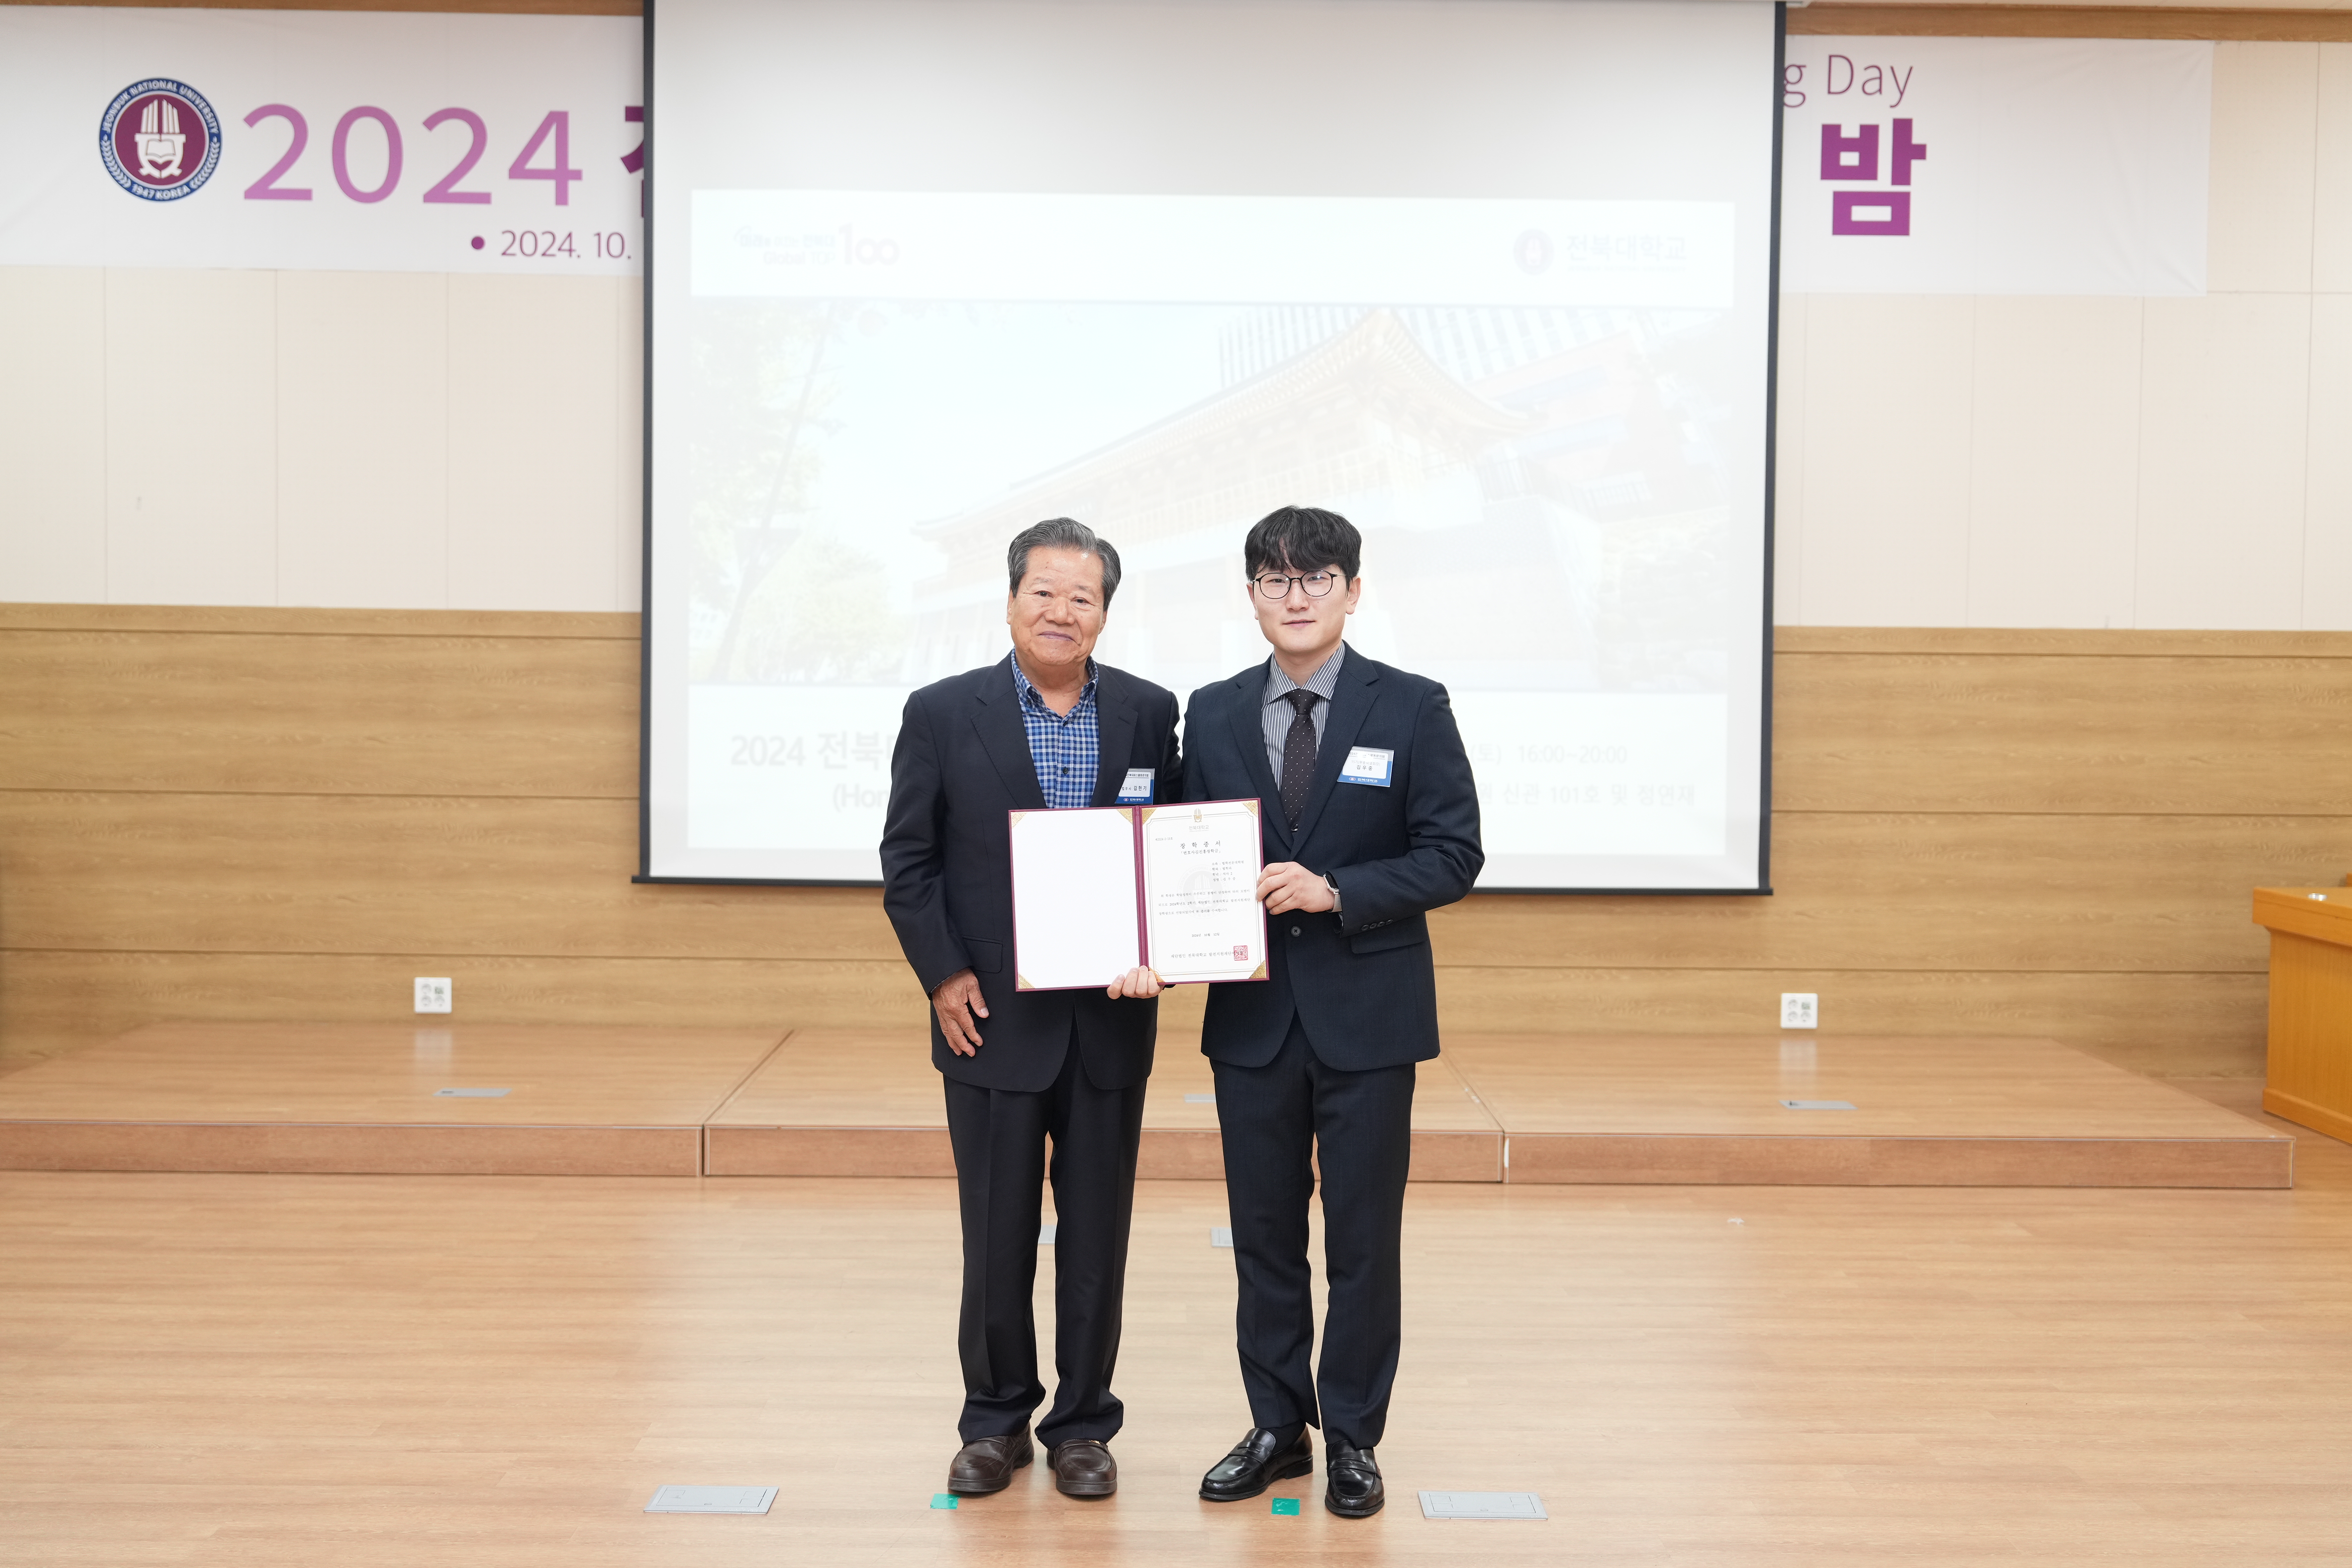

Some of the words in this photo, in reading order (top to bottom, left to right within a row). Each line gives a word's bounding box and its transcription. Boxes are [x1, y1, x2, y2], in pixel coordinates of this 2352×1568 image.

[1827, 54, 1913, 108] Day
[102, 91, 131, 133] JEONBUK
[129, 80, 178, 96] NATIONAL
[179, 85, 219, 134] UNIVERSITY
[243, 103, 584, 206] 2024
[131, 184, 155, 198] 1947
[155, 185, 192, 200] KOREA
[1821, 118, 1926, 236] 밤
[501, 230, 582, 258] 2024.
[593, 231, 632, 260] 10.
[763, 250, 805, 265] Global
[810, 250, 836, 265] TOP
[1565, 234, 1686, 262] 전북대학교
[731, 735, 806, 766] 2024
[1518, 744, 1628, 764] 16:00~20:00
[1504, 781, 1540, 805] 신관
[1550, 784, 1602, 803] 101호
[1611, 784, 1628, 806] 및
[1637, 784, 1695, 806] 정연재
